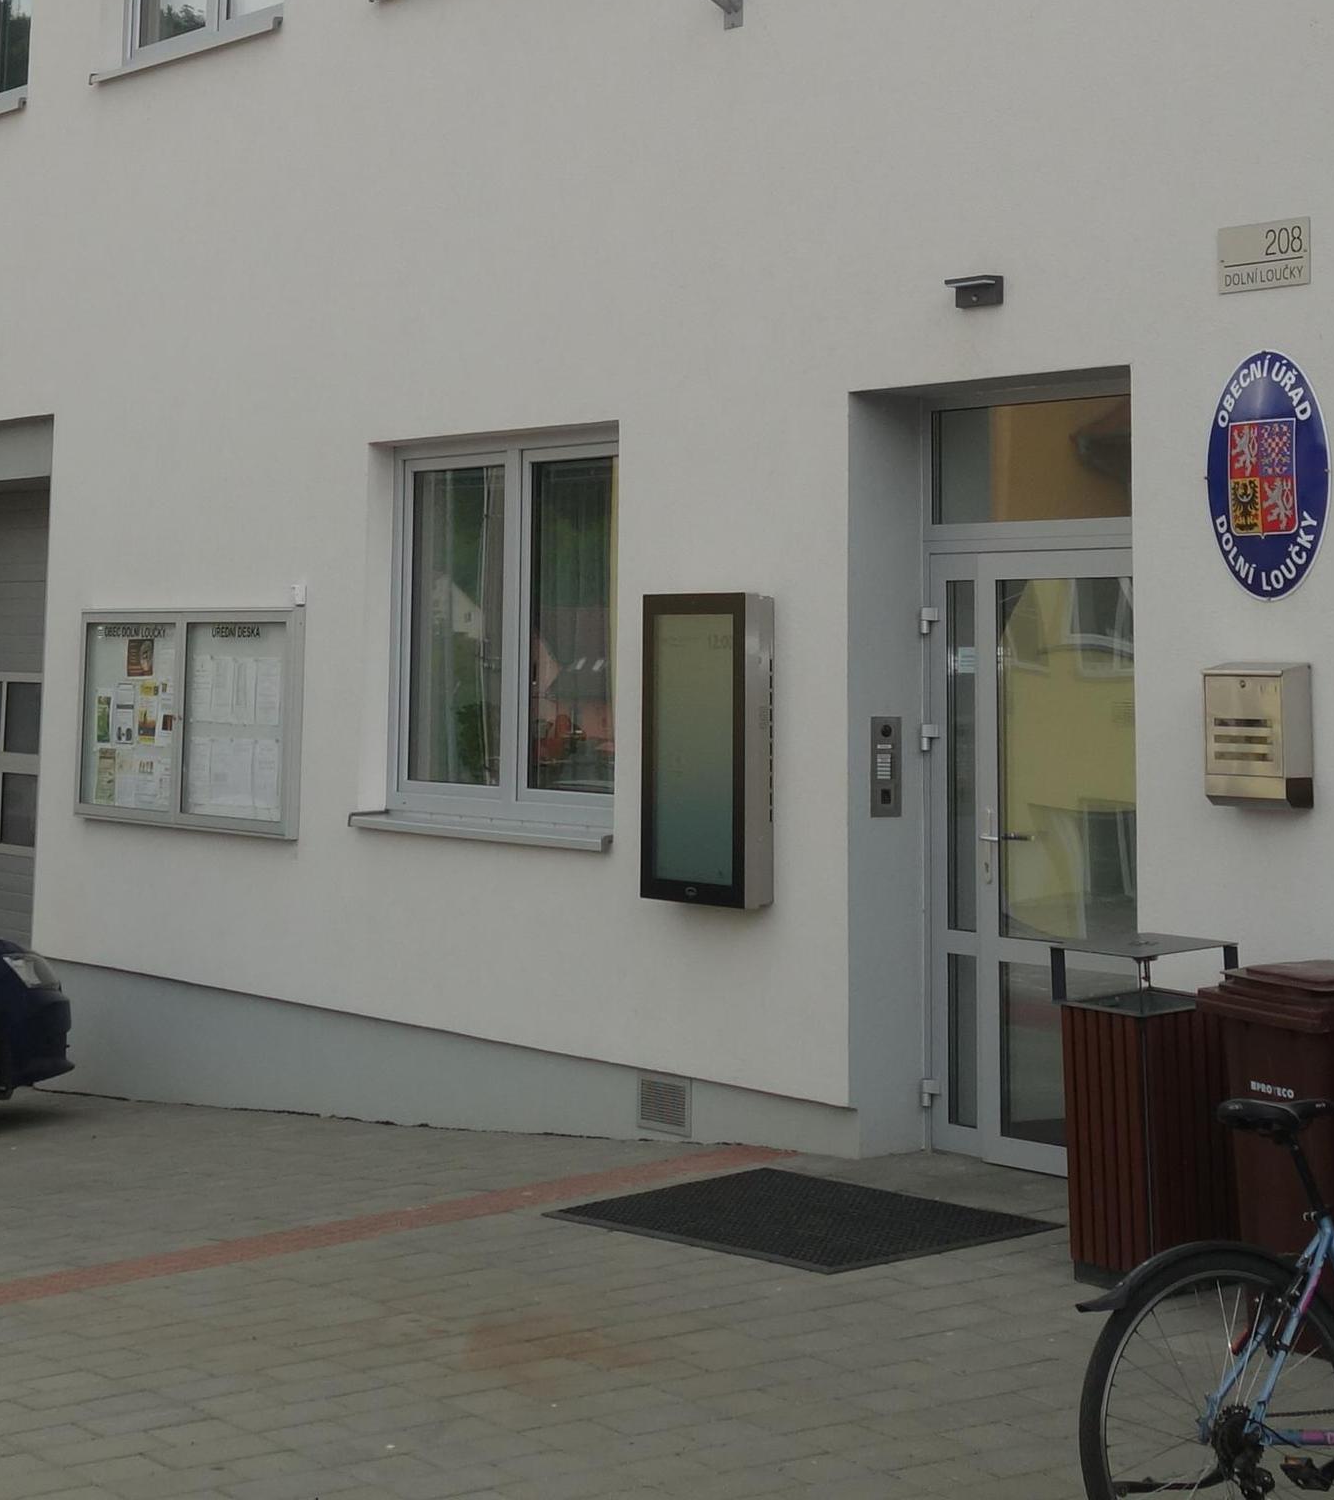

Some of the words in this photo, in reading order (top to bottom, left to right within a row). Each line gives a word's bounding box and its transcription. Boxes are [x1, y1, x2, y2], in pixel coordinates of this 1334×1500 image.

[1264, 225, 1303, 257] 208
[1224, 268, 1259, 287] DOLNÍ
[1260, 264, 1304, 283] LOUČKY
[1218, 354, 1271, 429] OBECNÍ
[1271, 359, 1312, 422] ÚŘAD
[1215, 514, 1257, 585] DOLNÍ
[1261, 510, 1318, 592] LOUČKY
[104, 626, 121, 638] OBEC
[122, 625, 140, 638] DOLNÍ
[141, 626, 166, 638] LOUČKY
[211, 624, 236, 638] ÚŘEDNÍ
[237, 626, 261, 638] DESKA
